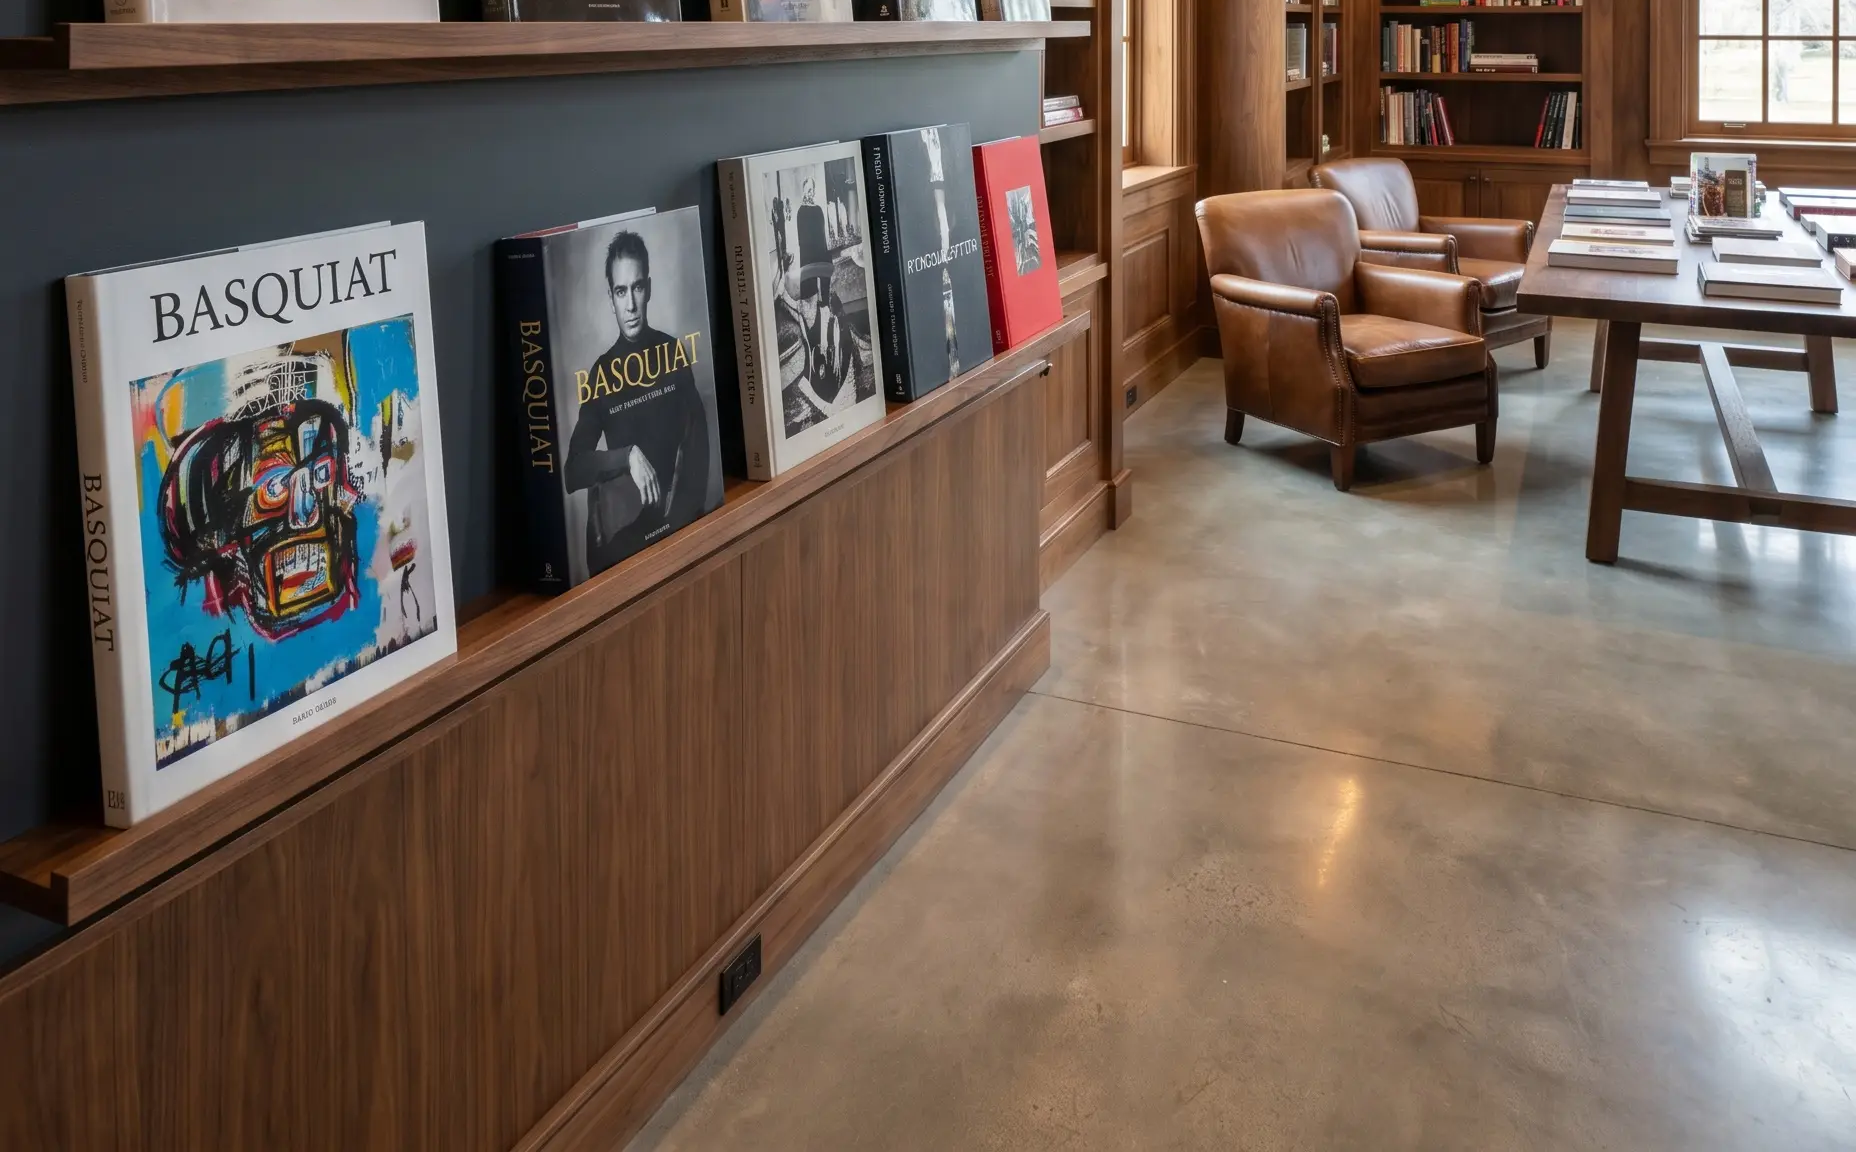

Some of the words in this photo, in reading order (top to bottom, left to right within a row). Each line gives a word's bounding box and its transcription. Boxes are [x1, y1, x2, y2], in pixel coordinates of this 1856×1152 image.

[150, 249, 398, 343] BASQUIAT
[519, 320, 553, 474] BASQUIAT
[574, 331, 701, 405] BASQUIAT
[83, 474, 115, 652] BASQUIAT
